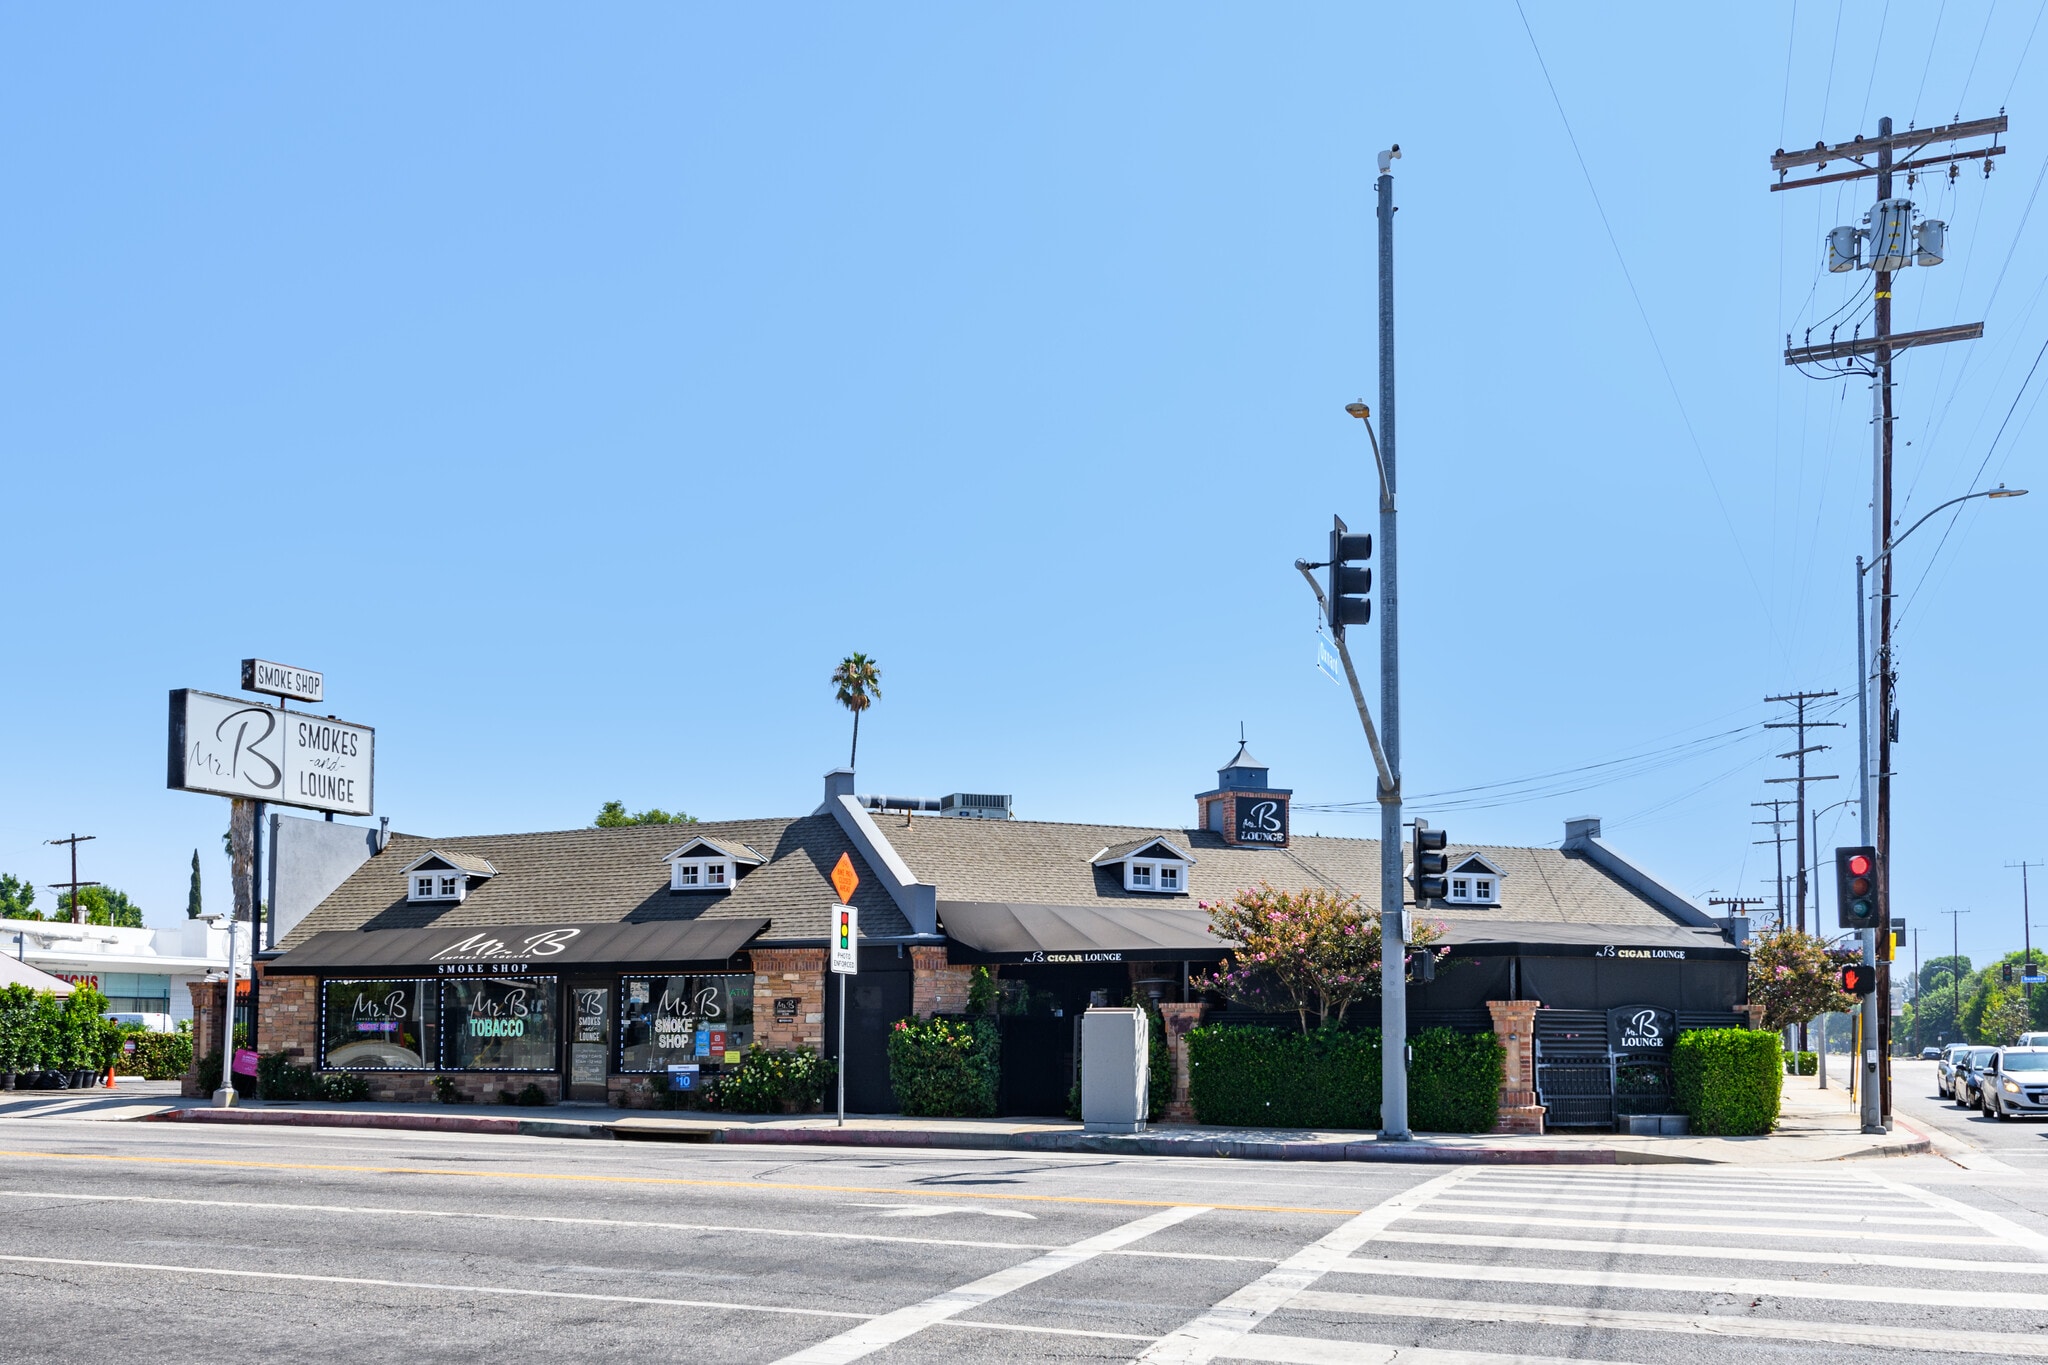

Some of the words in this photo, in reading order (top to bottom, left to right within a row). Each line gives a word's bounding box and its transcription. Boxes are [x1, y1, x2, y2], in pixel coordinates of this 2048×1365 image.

[258, 665, 292, 690] SMOKE
[296, 673, 320, 696] SHOP
[298, 722, 358, 757] SMOKES
[188, 741, 230, 776] Mr.
[216, 708, 282, 790] B
[300, 770, 355, 804] LOUNGE
[1250, 802, 1282, 832] B
[1241, 831, 1284, 842] LOUNGE
[429, 932, 512, 960] Mr.
[522, 928, 581, 956] B
[837, 952, 851, 960] PHOTO
[1085, 953, 1122, 962] LOUNGE
[1618, 950, 1651, 958] CIGAR
[1652, 950, 1686, 960] LOUNGE
[438, 964, 484, 974] SMOKE
[492, 964, 528, 973] SHOP
[834, 960, 854, 969] ENFORCED
[352, 992, 385, 1021] Mr.
[384, 990, 407, 1018] B
[470, 991, 506, 1020] Mr.
[504, 988, 528, 1017] B
[581, 989, 603, 1016] B
[657, 990, 695, 1019] Mr.
[694, 987, 720, 1017] B
[470, 1019, 524, 1037] TOBACCO
[579, 1017, 601, 1026] SMOKES
[655, 1019, 693, 1033] SMOKE
[1632, 1010, 1659, 1038] B
[579, 1032, 600, 1041] LOUNGE
[658, 1034, 689, 1048] SHOP
[1621, 1037, 1664, 1047] LOUNGE
[675, 1076, 690, 1086] $10
